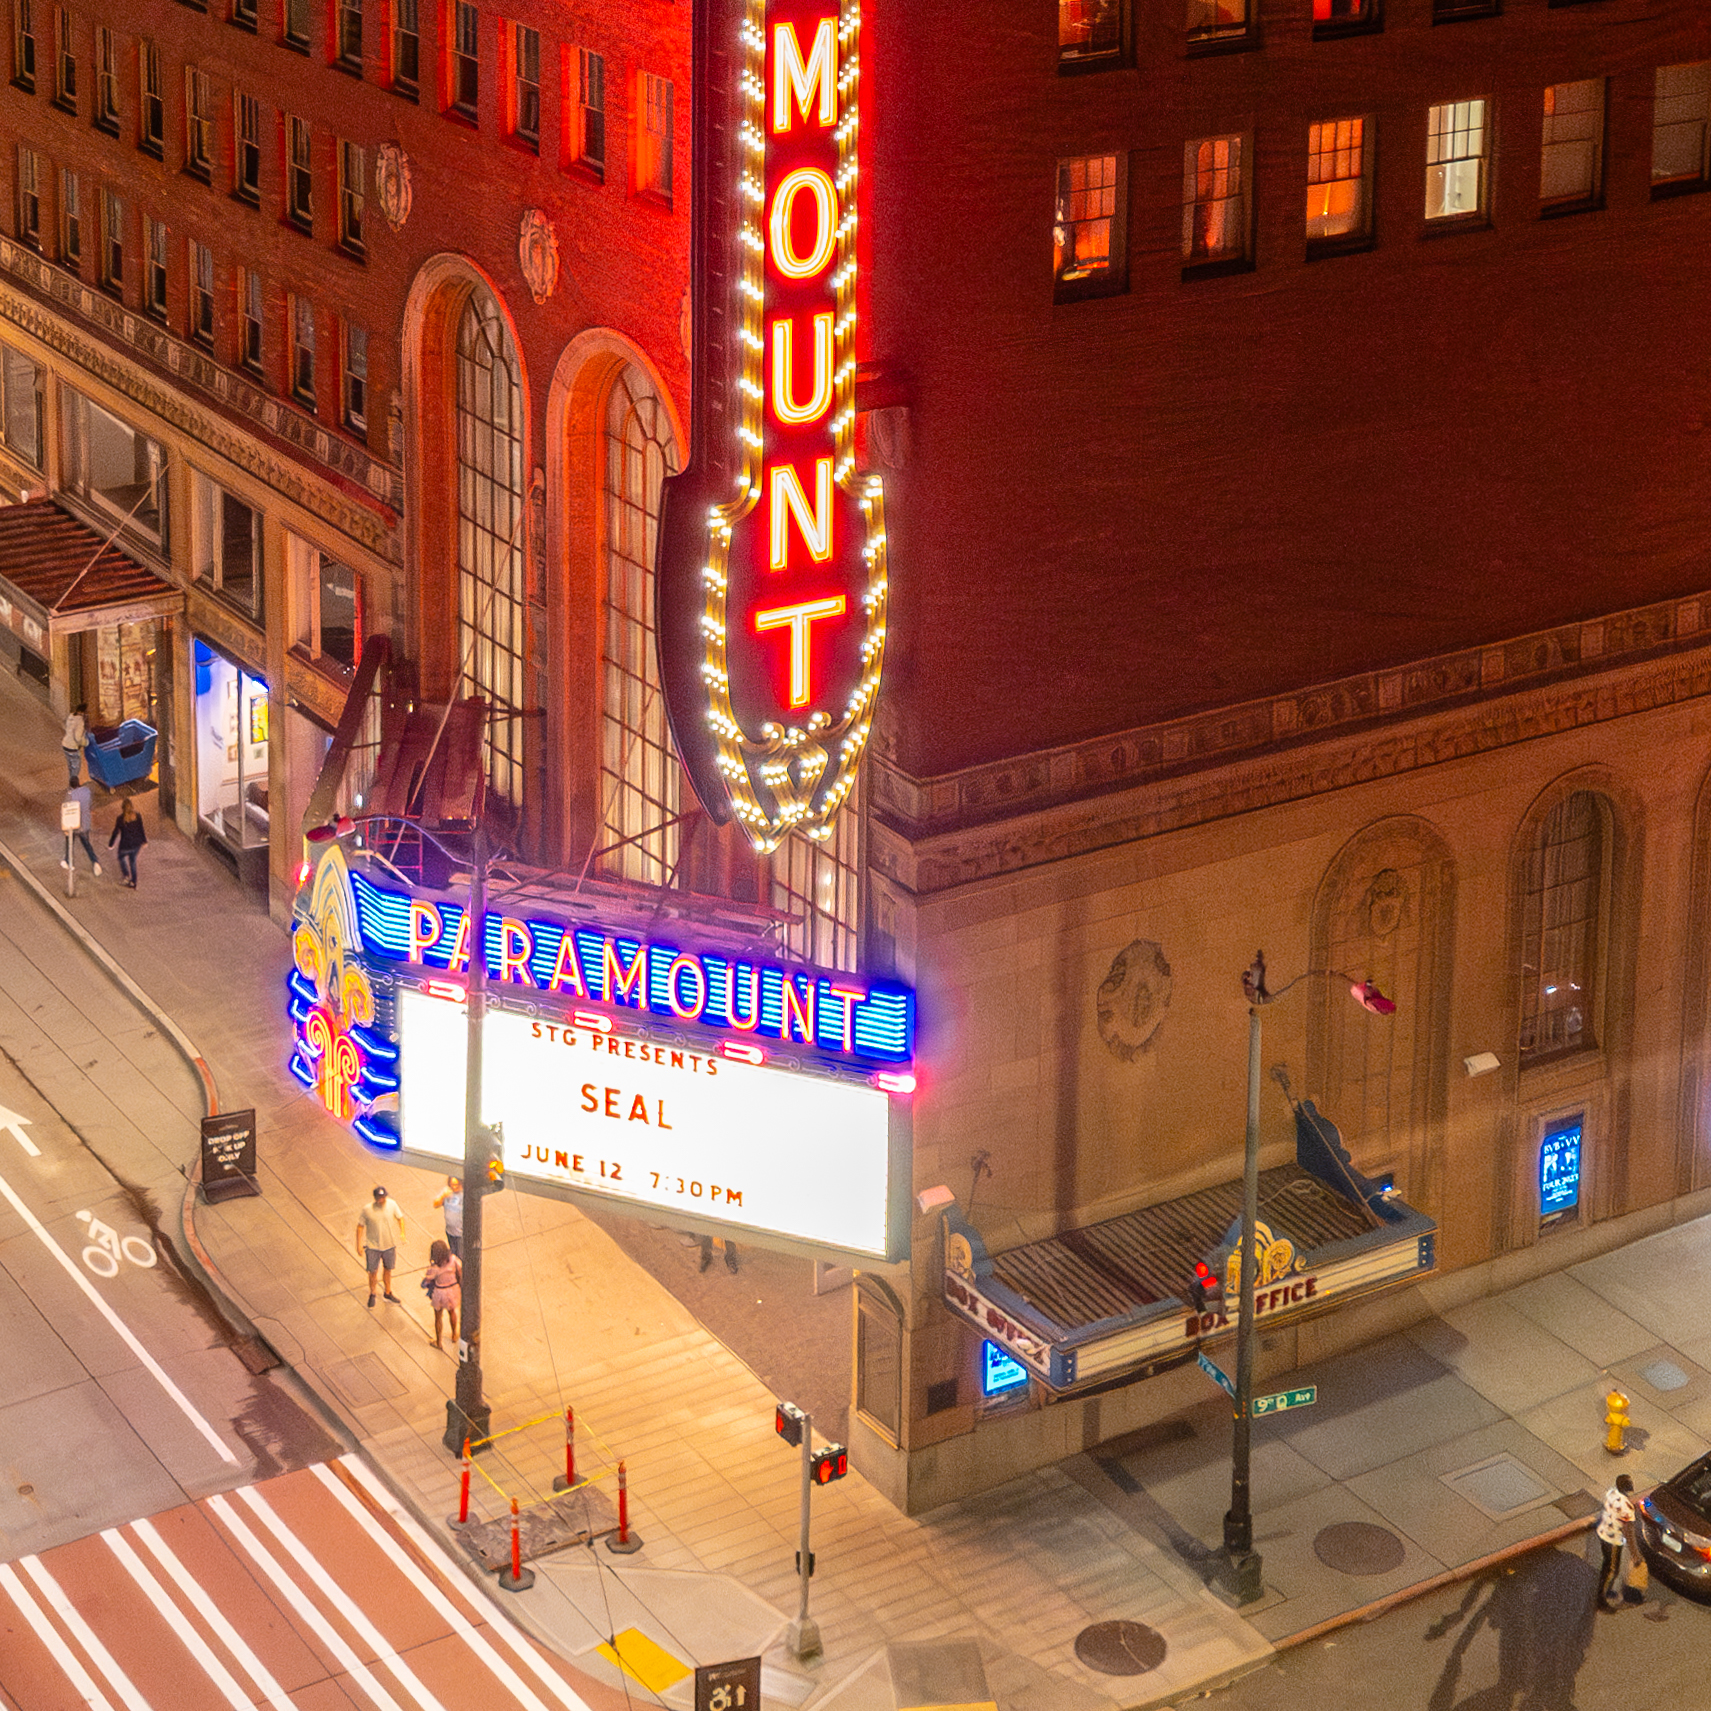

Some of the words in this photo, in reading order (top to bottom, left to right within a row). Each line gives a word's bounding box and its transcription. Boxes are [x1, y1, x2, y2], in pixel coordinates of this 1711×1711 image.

[407, 901, 867, 1053] PARAMOUNT
[530, 1020, 577, 1047] STG
[592, 1033, 719, 1077] PRESENTS
[579, 1082, 674, 1131] SEAL
[520, 1144, 585, 1172] JUNE
[599, 1159, 623, 1180] 12
[1255, 1277, 1319, 1315] FFICE
